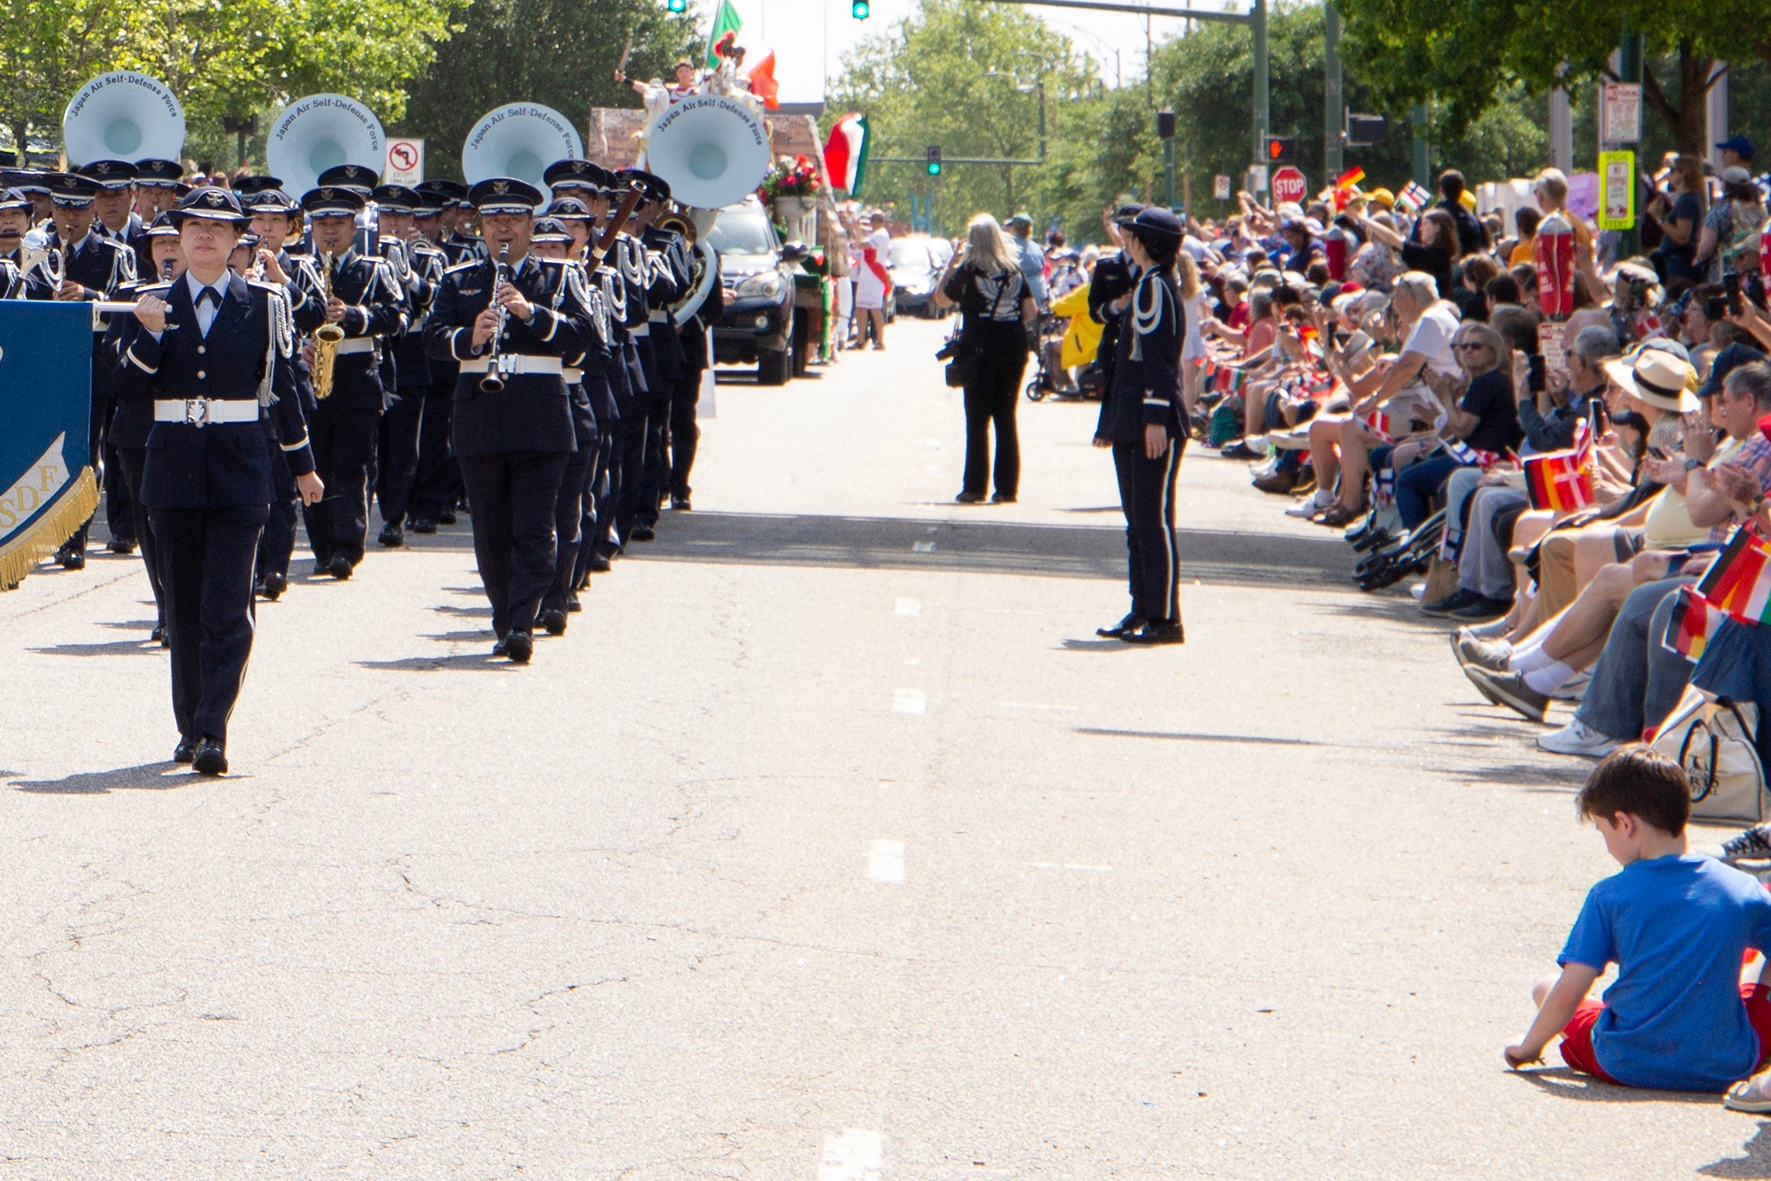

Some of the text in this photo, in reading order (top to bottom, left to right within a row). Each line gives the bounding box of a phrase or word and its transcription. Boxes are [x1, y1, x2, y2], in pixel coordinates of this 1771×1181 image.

[71, 74, 178, 118] Japan Air Self-Defense Force
[275, 98, 378, 152] Japan Air Self-Defense Force
[470, 107, 574, 159] Japan Air Self-Defense Force
[658, 98, 763, 146] Japan Air Self-Defense Force
[1275, 178, 1305, 195] STOP
